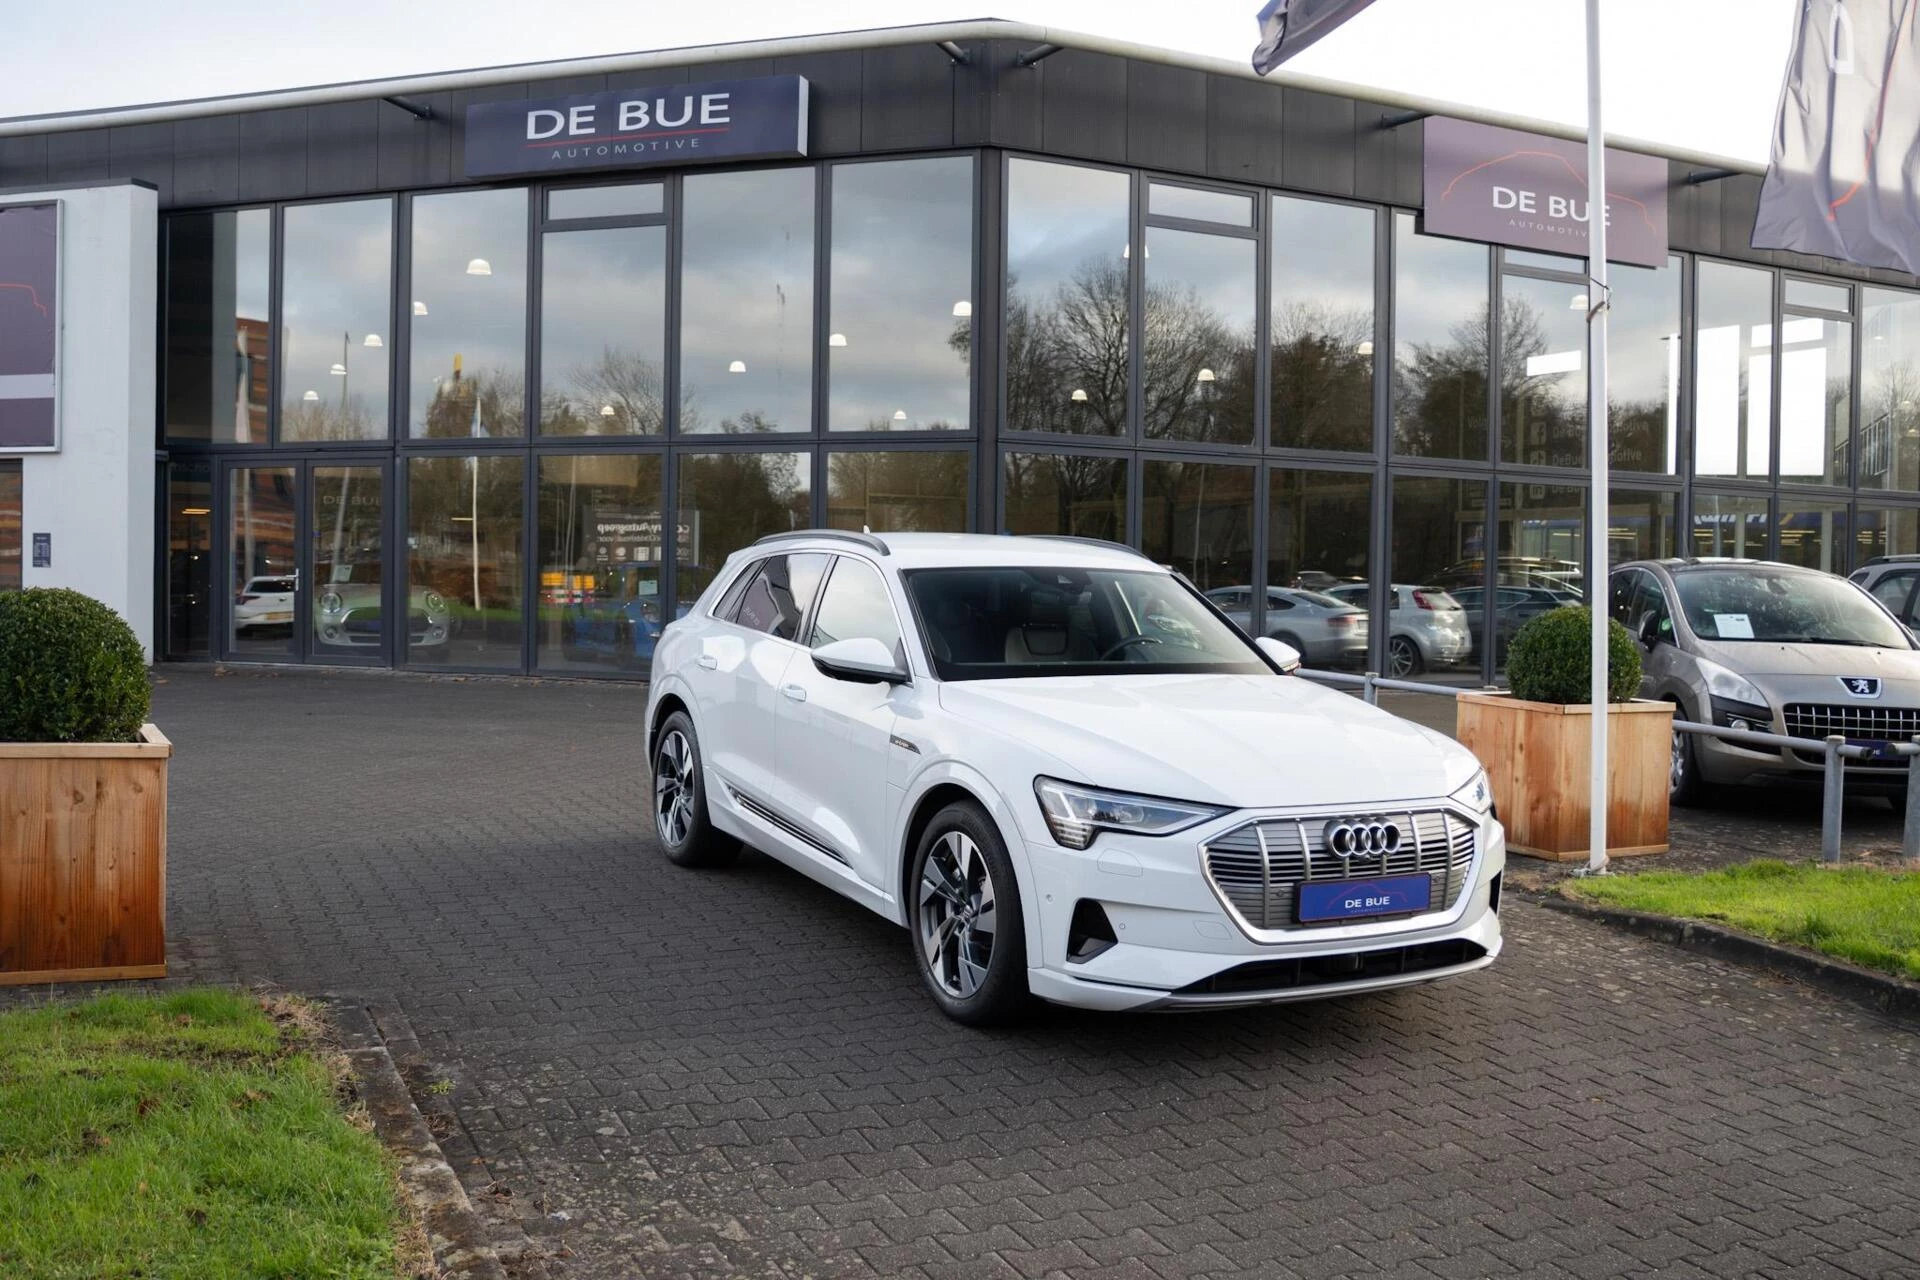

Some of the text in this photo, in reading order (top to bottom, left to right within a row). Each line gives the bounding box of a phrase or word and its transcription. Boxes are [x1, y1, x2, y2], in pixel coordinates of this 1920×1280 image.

[527, 92, 730, 140] DE BUE
[551, 138, 701, 160] AUTOMOTIVE
[1492, 186, 1536, 214] DE
[1509, 219, 1588, 237] AUTOMOTIV
[1345, 896, 1390, 909] DE BUE
